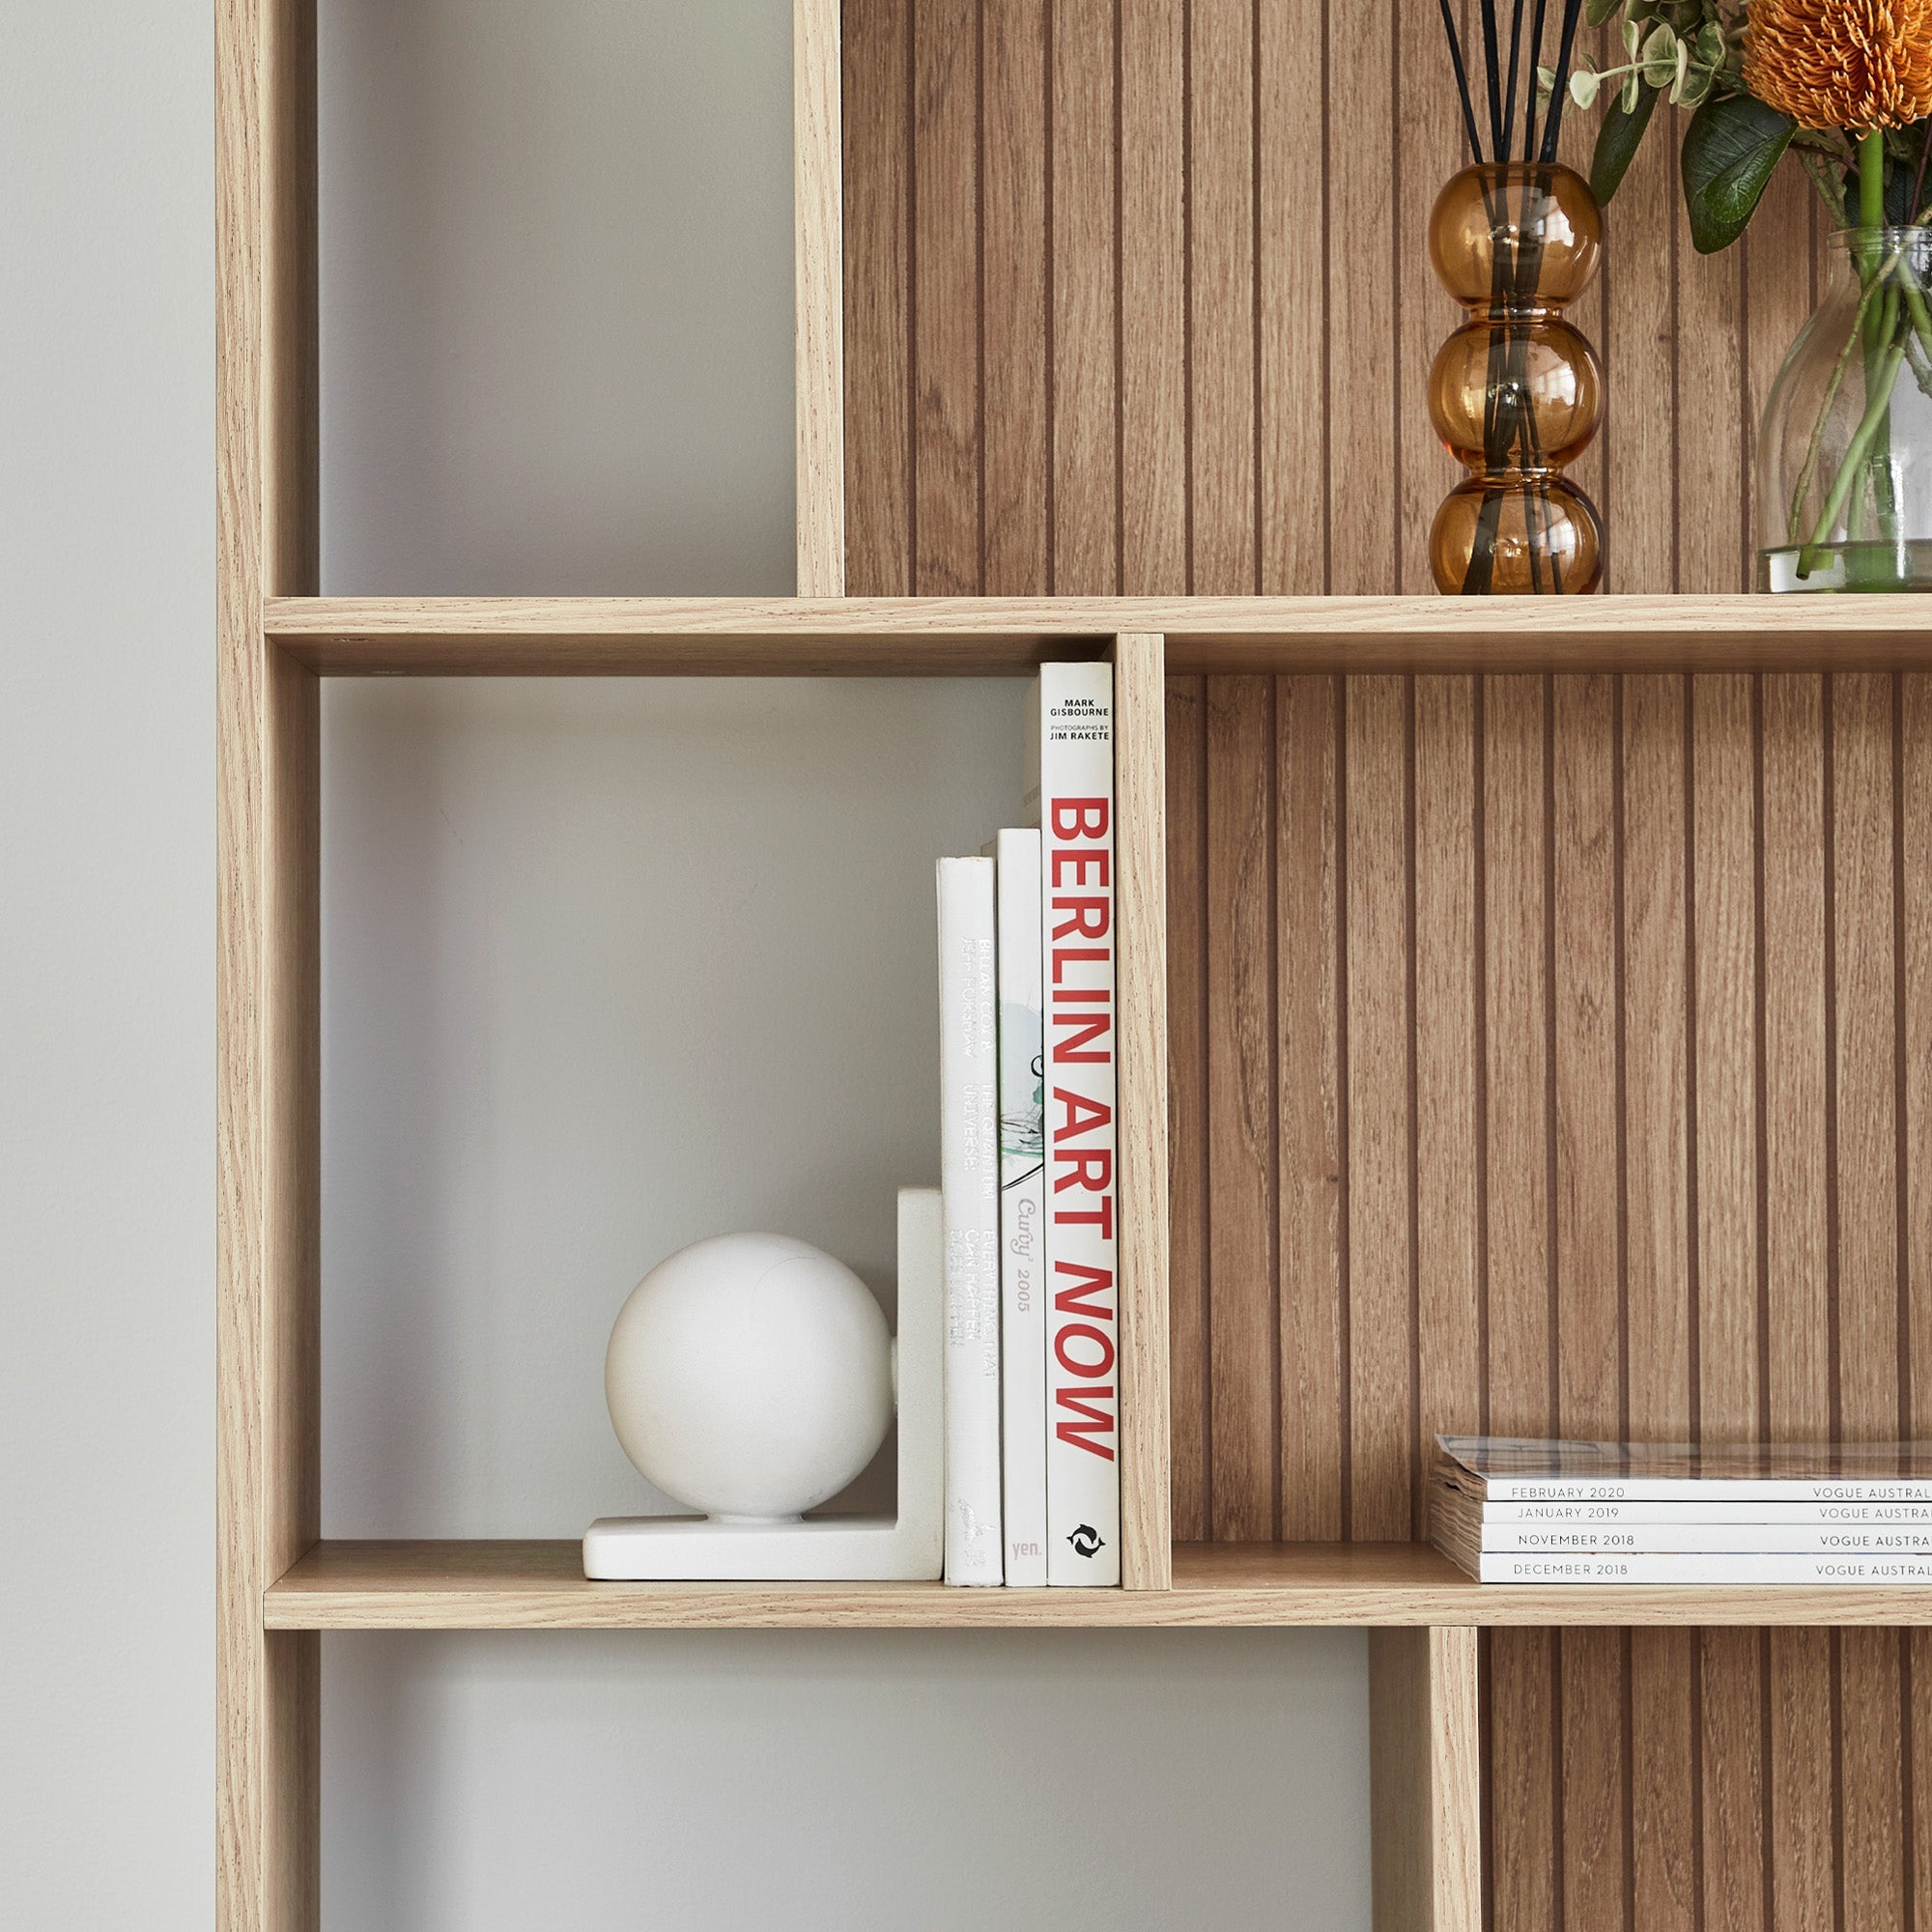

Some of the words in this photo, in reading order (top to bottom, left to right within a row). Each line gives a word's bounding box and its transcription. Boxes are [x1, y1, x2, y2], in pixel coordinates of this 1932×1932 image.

[1064, 698, 1094, 707] MARK
[1050, 708, 1109, 717] GISBOURNE
[1049, 732, 1067, 741] JIM
[1070, 731, 1110, 741] RAKETE
[1050, 797, 1111, 1064] BERLIN
[1053, 1087, 1113, 1239] ART
[1017, 1269, 1031, 1312] 2005
[1054, 1261, 1116, 1462] NOW
[1512, 1487, 1584, 1498] FEBRUARY
[1590, 1487, 1625, 1498] 2020
[1812, 1487, 1863, 1498] VOGUE
[1518, 1507, 1582, 1519] JANUARY
[1587, 1507, 1619, 1519] 2019
[1819, 1507, 1869, 1520] VOGUE
[1874, 1507, 1932, 1520] AUSTRA
[1519, 1534, 1598, 1546] NOVEMBER
[1603, 1534, 1634, 1546] 2018
[1820, 1535, 1870, 1547] VOGUE
[1514, 1563, 1591, 1576] DECEMBER
[1597, 1563, 1629, 1576] 2018
[1815, 1564, 1865, 1576] VOGUE
